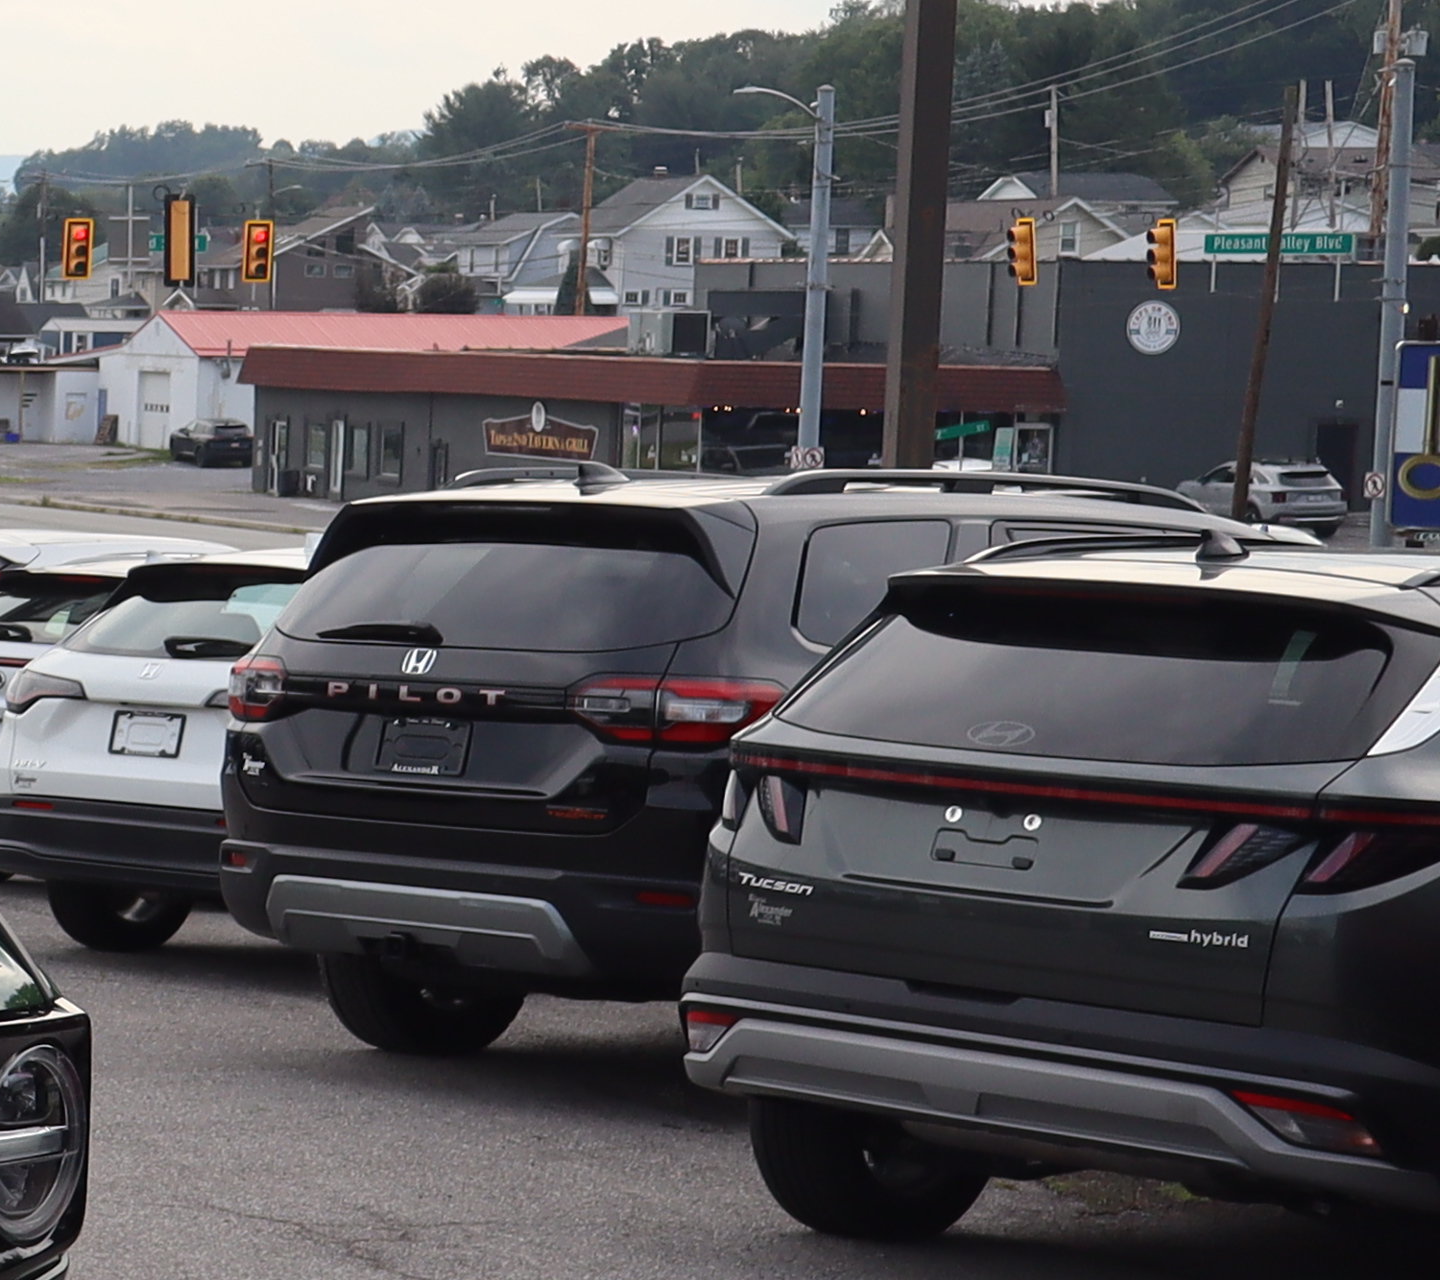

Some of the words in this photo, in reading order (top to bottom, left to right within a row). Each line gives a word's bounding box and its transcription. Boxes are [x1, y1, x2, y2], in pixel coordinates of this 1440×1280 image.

[1213, 236, 1267, 250] Pleasant
[1280, 236, 1311, 252] alley
[1315, 236, 1343, 250] Blvd
[327, 680, 506, 706] PILOT
[1190, 928, 1249, 948] hybrid
